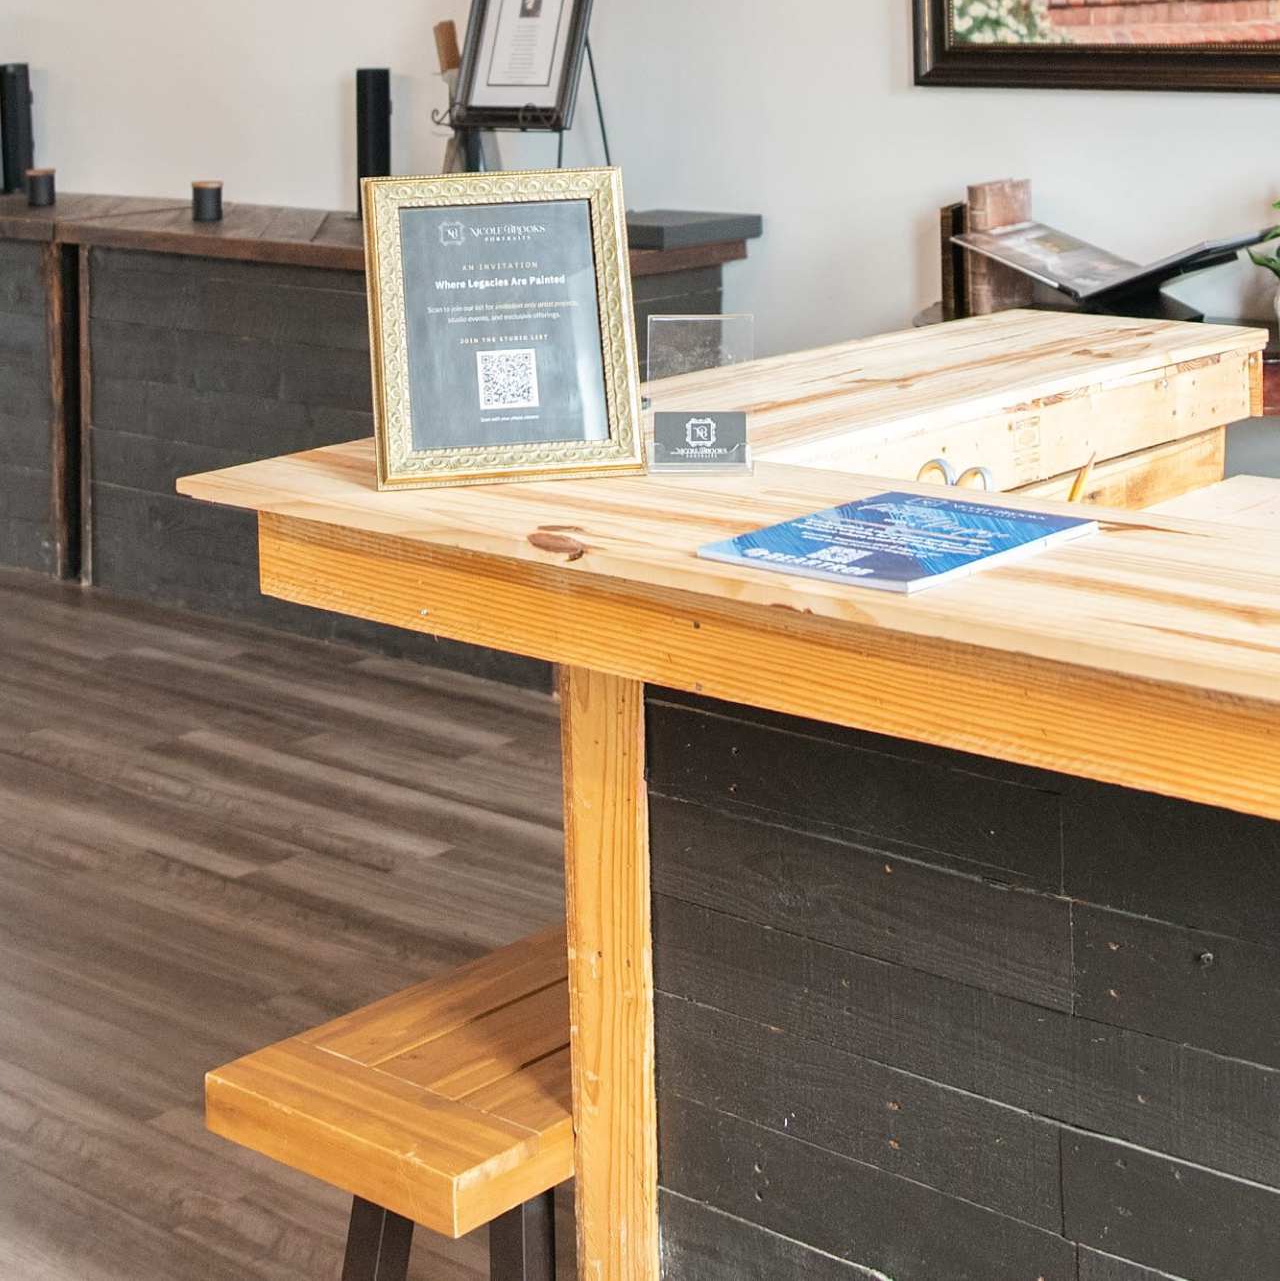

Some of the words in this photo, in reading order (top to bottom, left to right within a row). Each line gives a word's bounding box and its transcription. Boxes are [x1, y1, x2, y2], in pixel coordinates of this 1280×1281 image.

[479, 261, 538, 271] INVITATION
[435, 279, 466, 290] Where
[468, 277, 509, 289] Legacies
[511, 276, 527, 287] Are
[529, 274, 566, 286] Painted
